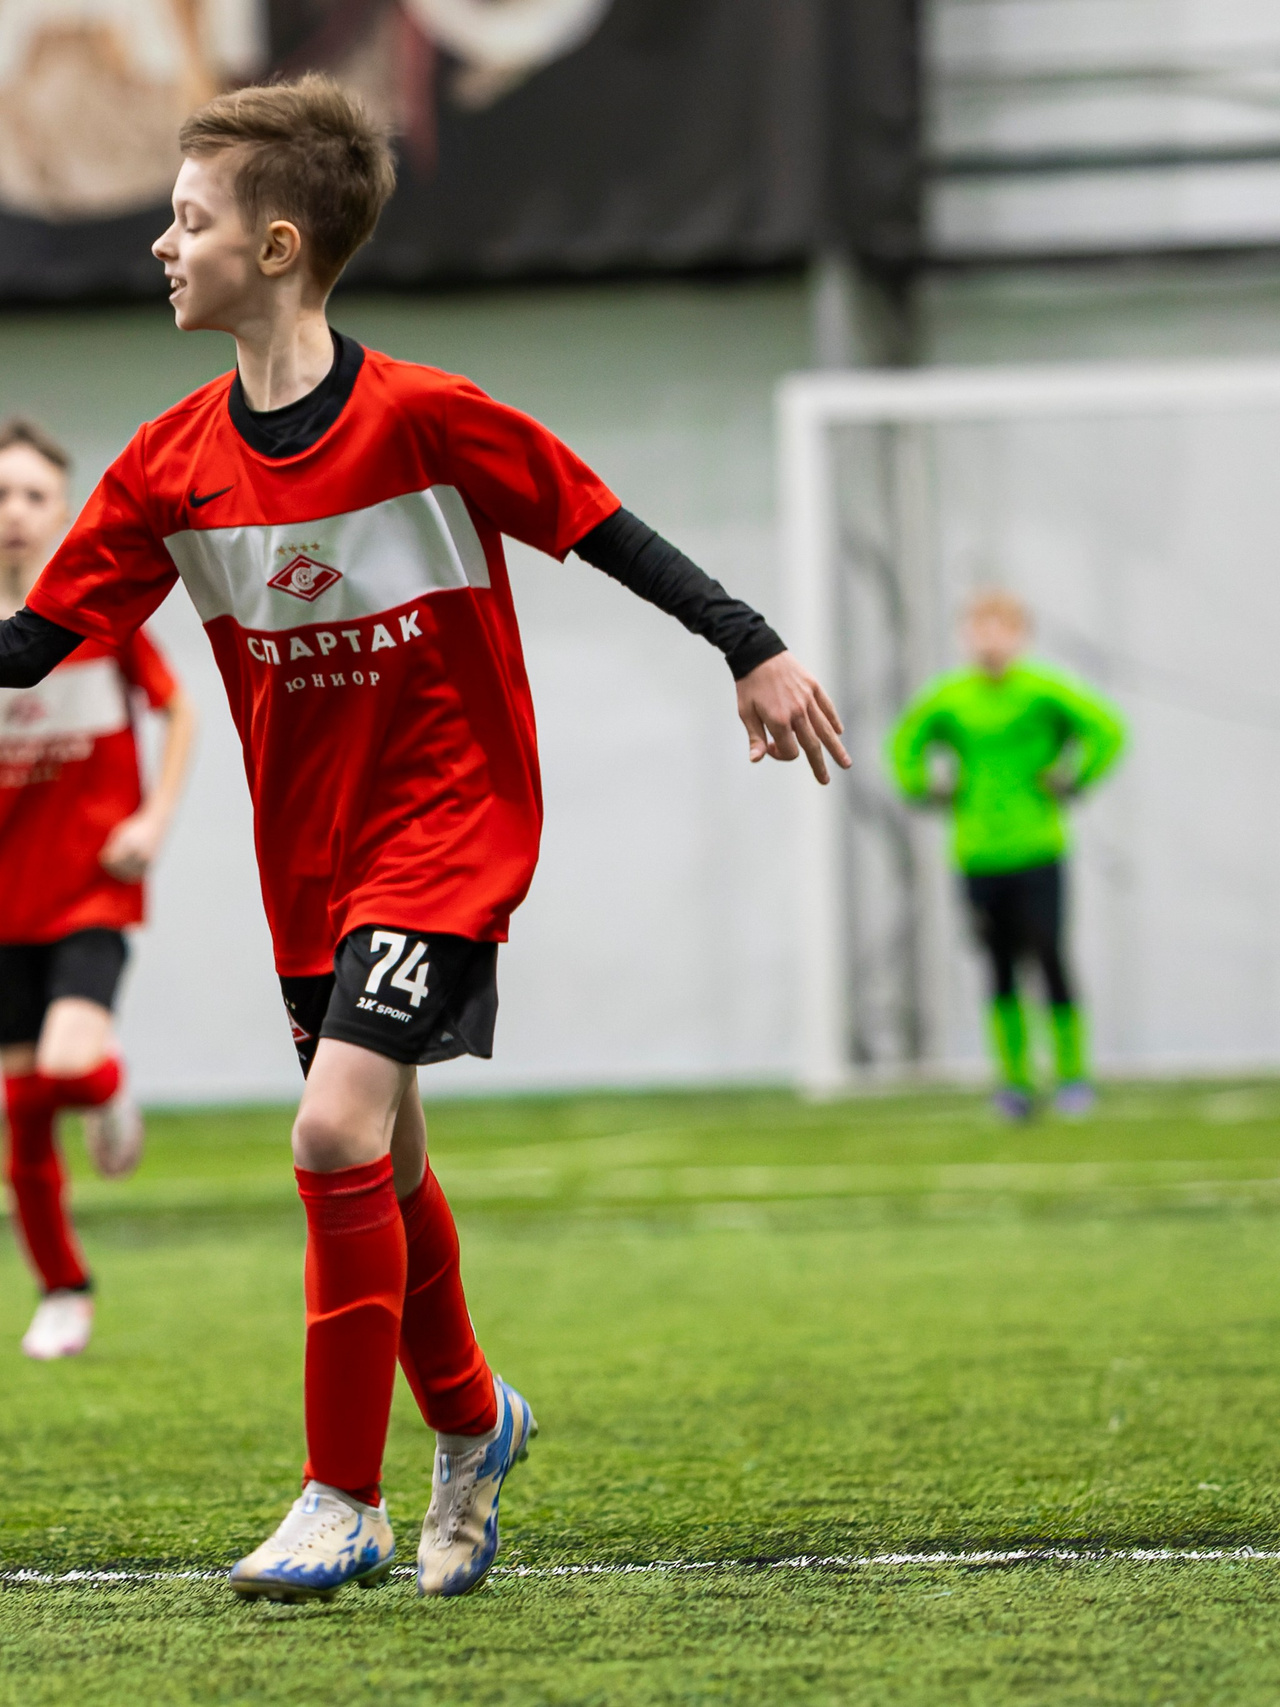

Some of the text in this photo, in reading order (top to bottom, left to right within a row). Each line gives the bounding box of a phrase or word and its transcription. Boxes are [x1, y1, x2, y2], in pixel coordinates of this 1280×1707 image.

[247, 609, 424, 666] СПАРТАК
[284, 670, 381, 694] ЮНИОР
[364, 930, 431, 1008] 74
[376, 1004, 412, 1023] SPORT
